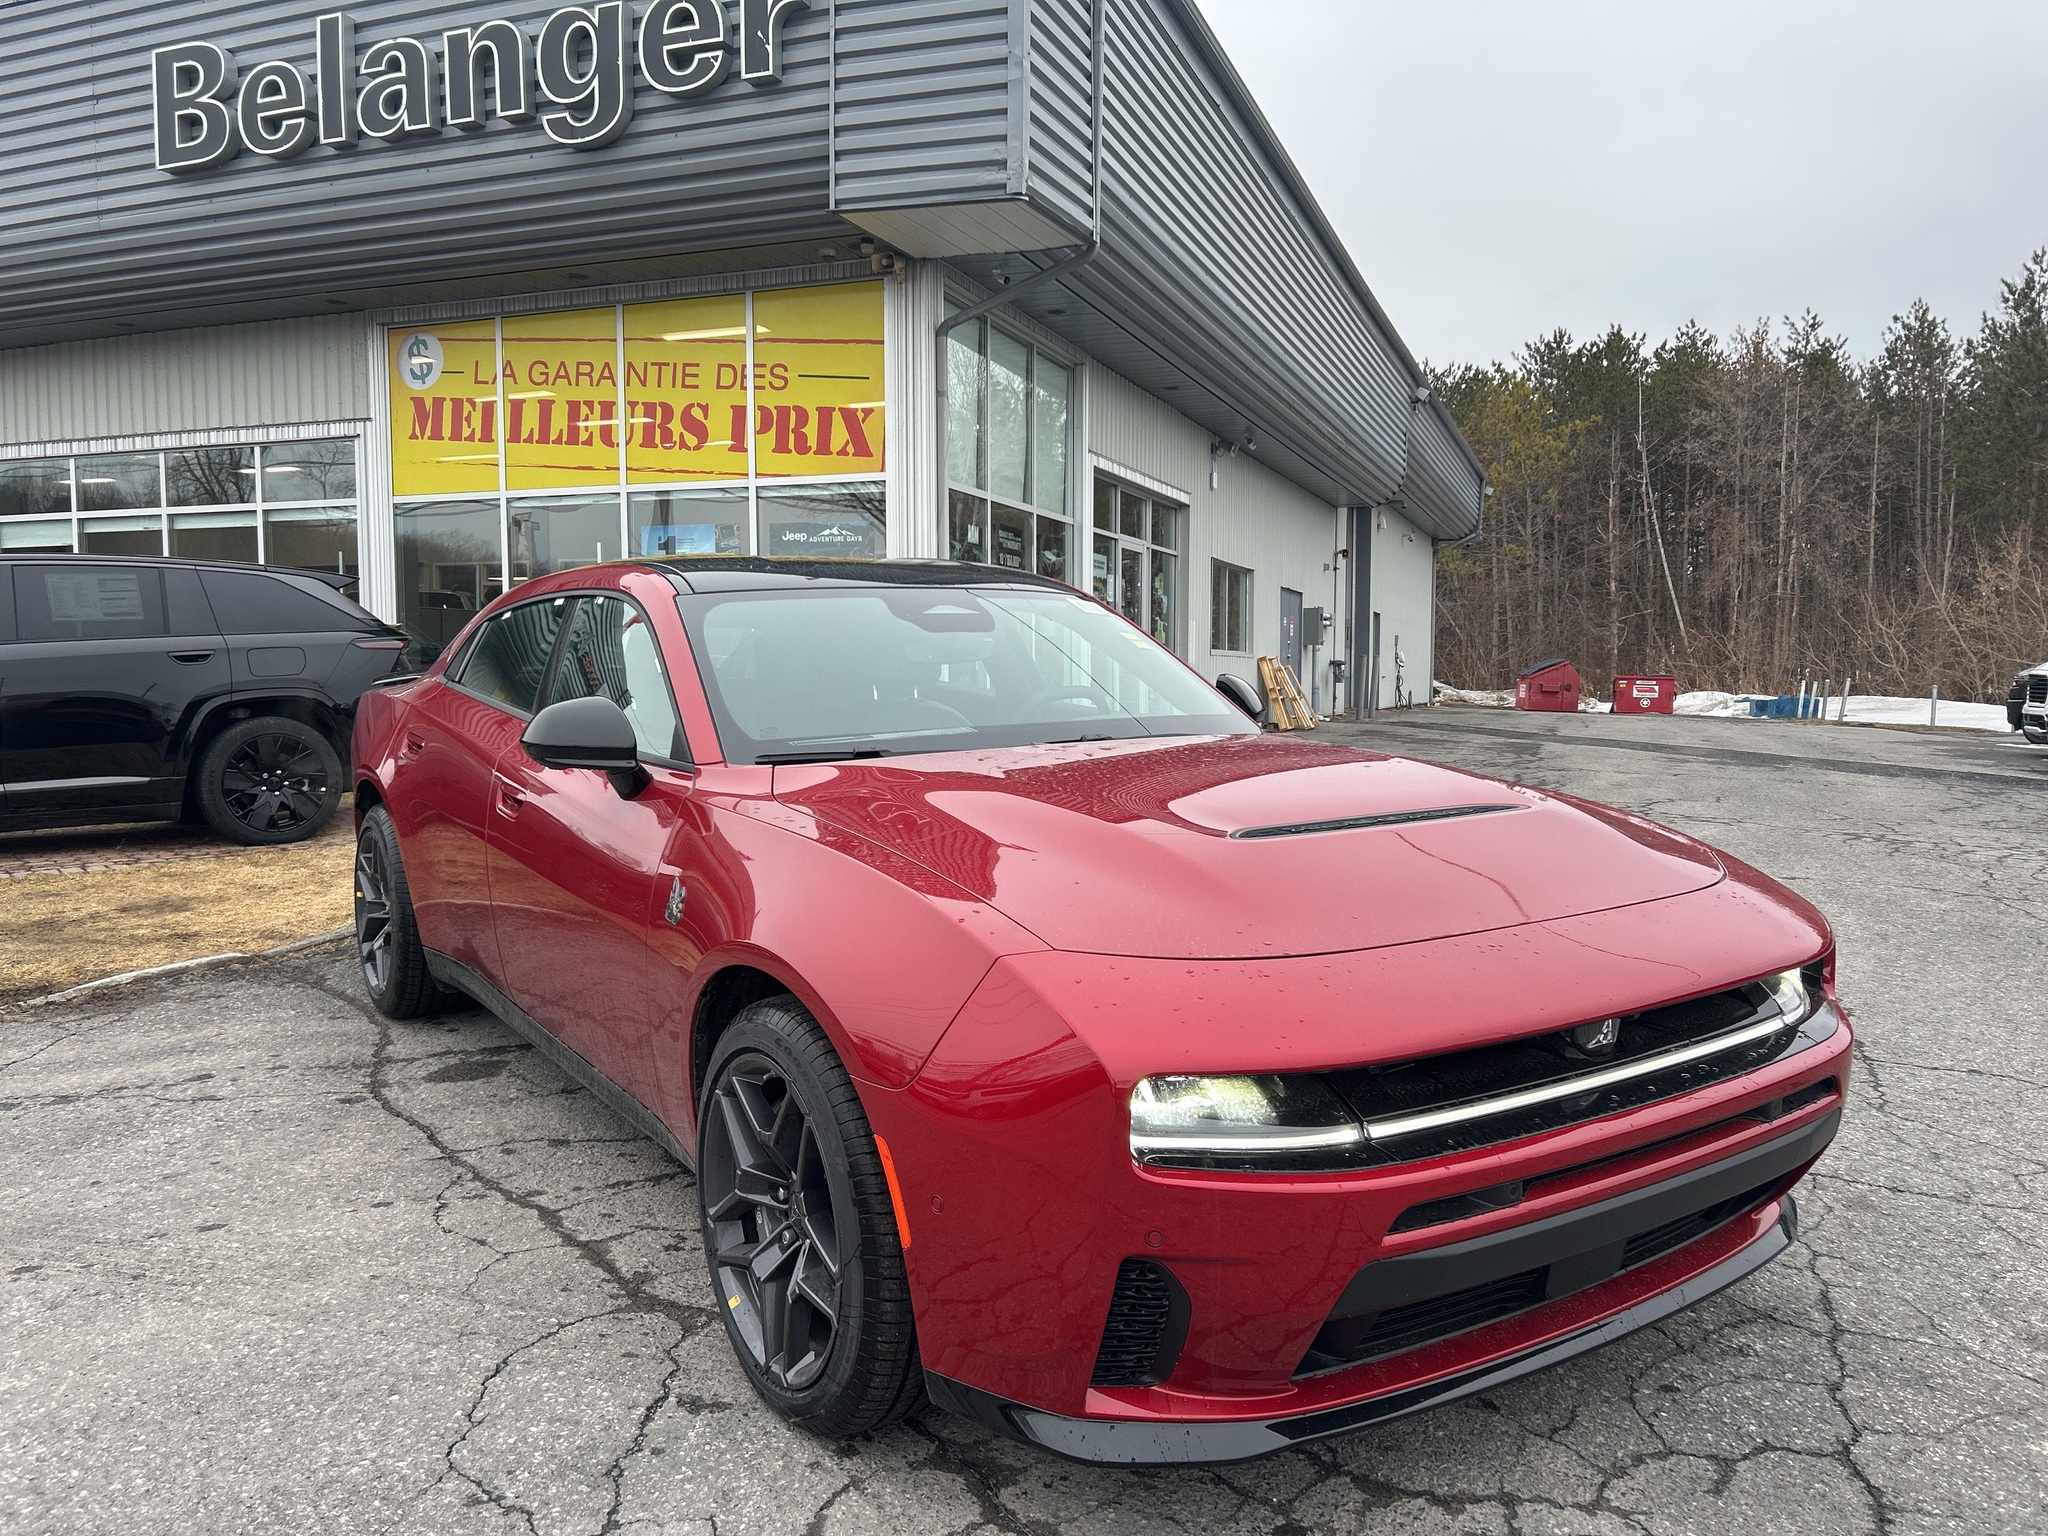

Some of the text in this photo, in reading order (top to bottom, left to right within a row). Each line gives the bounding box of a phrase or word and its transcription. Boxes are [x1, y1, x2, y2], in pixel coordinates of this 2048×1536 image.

[151, 0, 806, 172] Belanger
[473, 359, 790, 392] LA GARANTIE DES
[408, 396, 875, 458] MEILLEURS PRIX
[781, 530, 808, 543] Jeep
[808, 535, 845, 543] ADVENTURE
